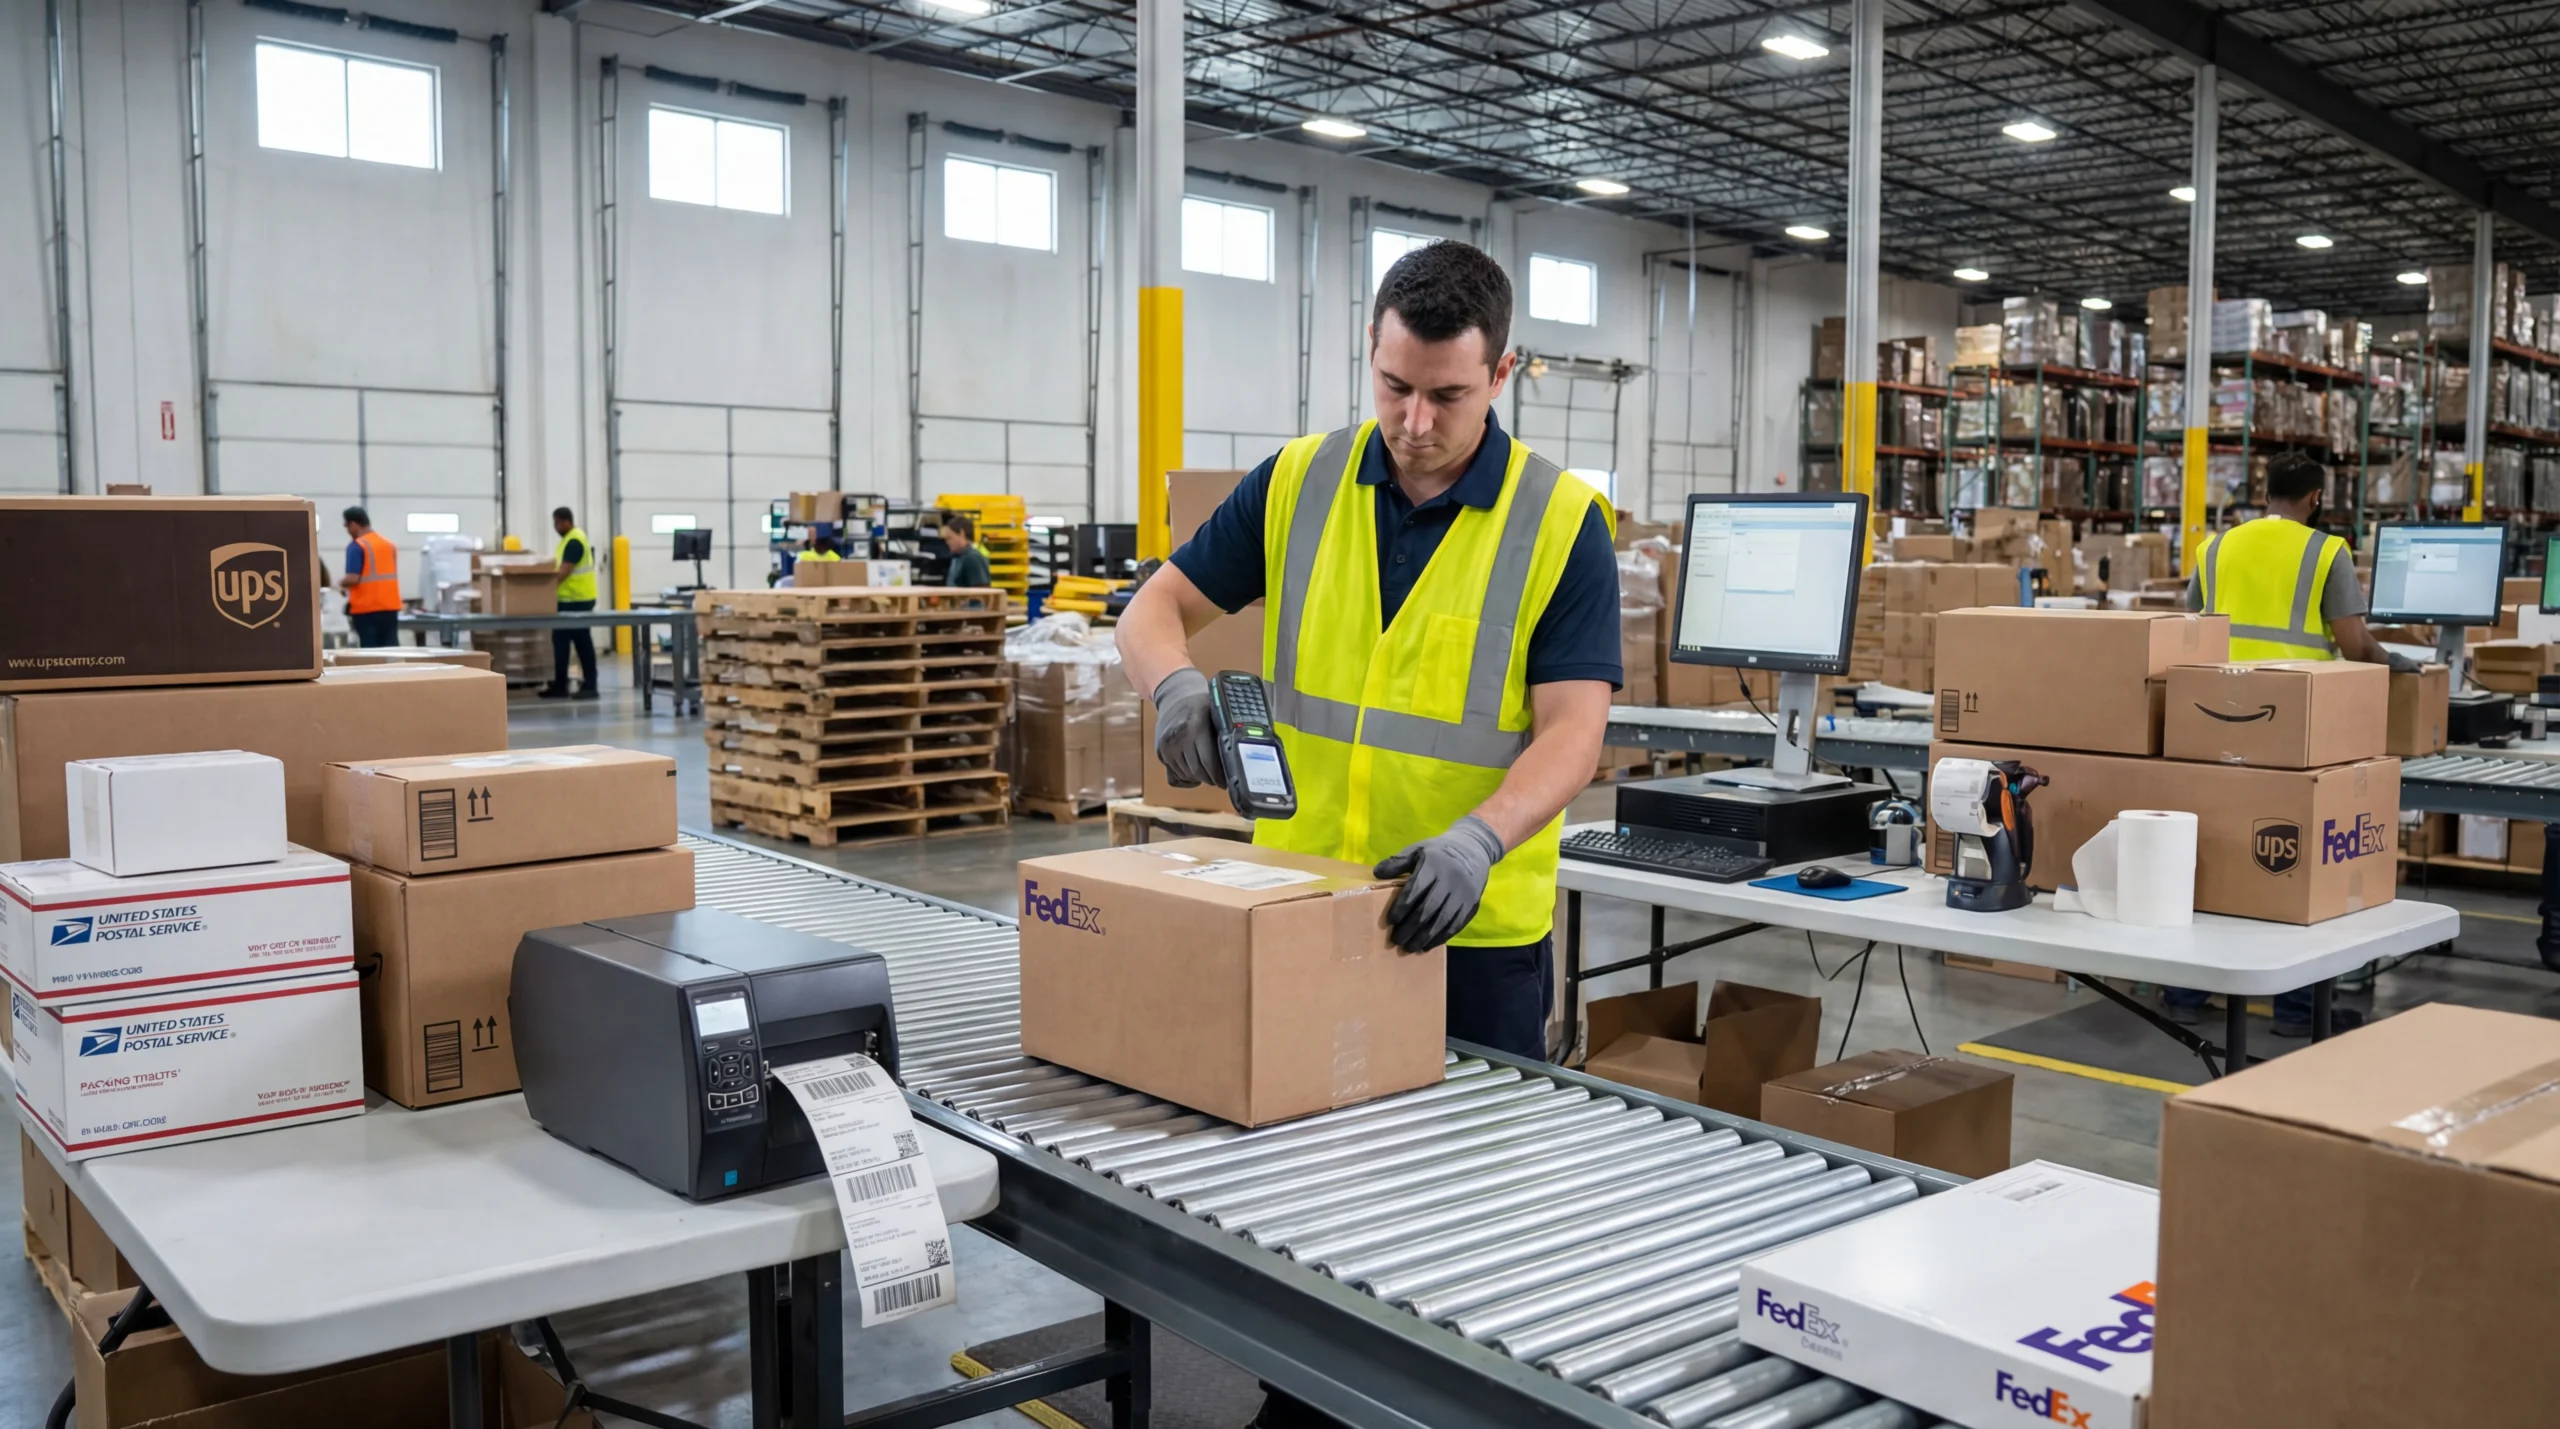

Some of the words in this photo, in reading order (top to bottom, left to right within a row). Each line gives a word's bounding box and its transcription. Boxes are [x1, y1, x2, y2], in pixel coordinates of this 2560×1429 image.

[217, 569, 283, 613] ups
[2256, 835, 2298, 866] ups
[2322, 812, 2386, 866] FedEx
[99, 910, 149, 925] UNITED
[152, 905, 197, 920] STATES
[1025, 879, 1101, 935] FedEx
[96, 927, 146, 942] POSTAL
[149, 920, 202, 936] SERVICE
[123, 1036, 173, 1052] POSTAL
[176, 1029, 229, 1045] SERVICE
[126, 1020, 177, 1036] UNITED
[179, 1013, 225, 1029] STATES
[1757, 1287, 1841, 1345] FedEx
[1996, 1369, 2092, 1429] FedEx
